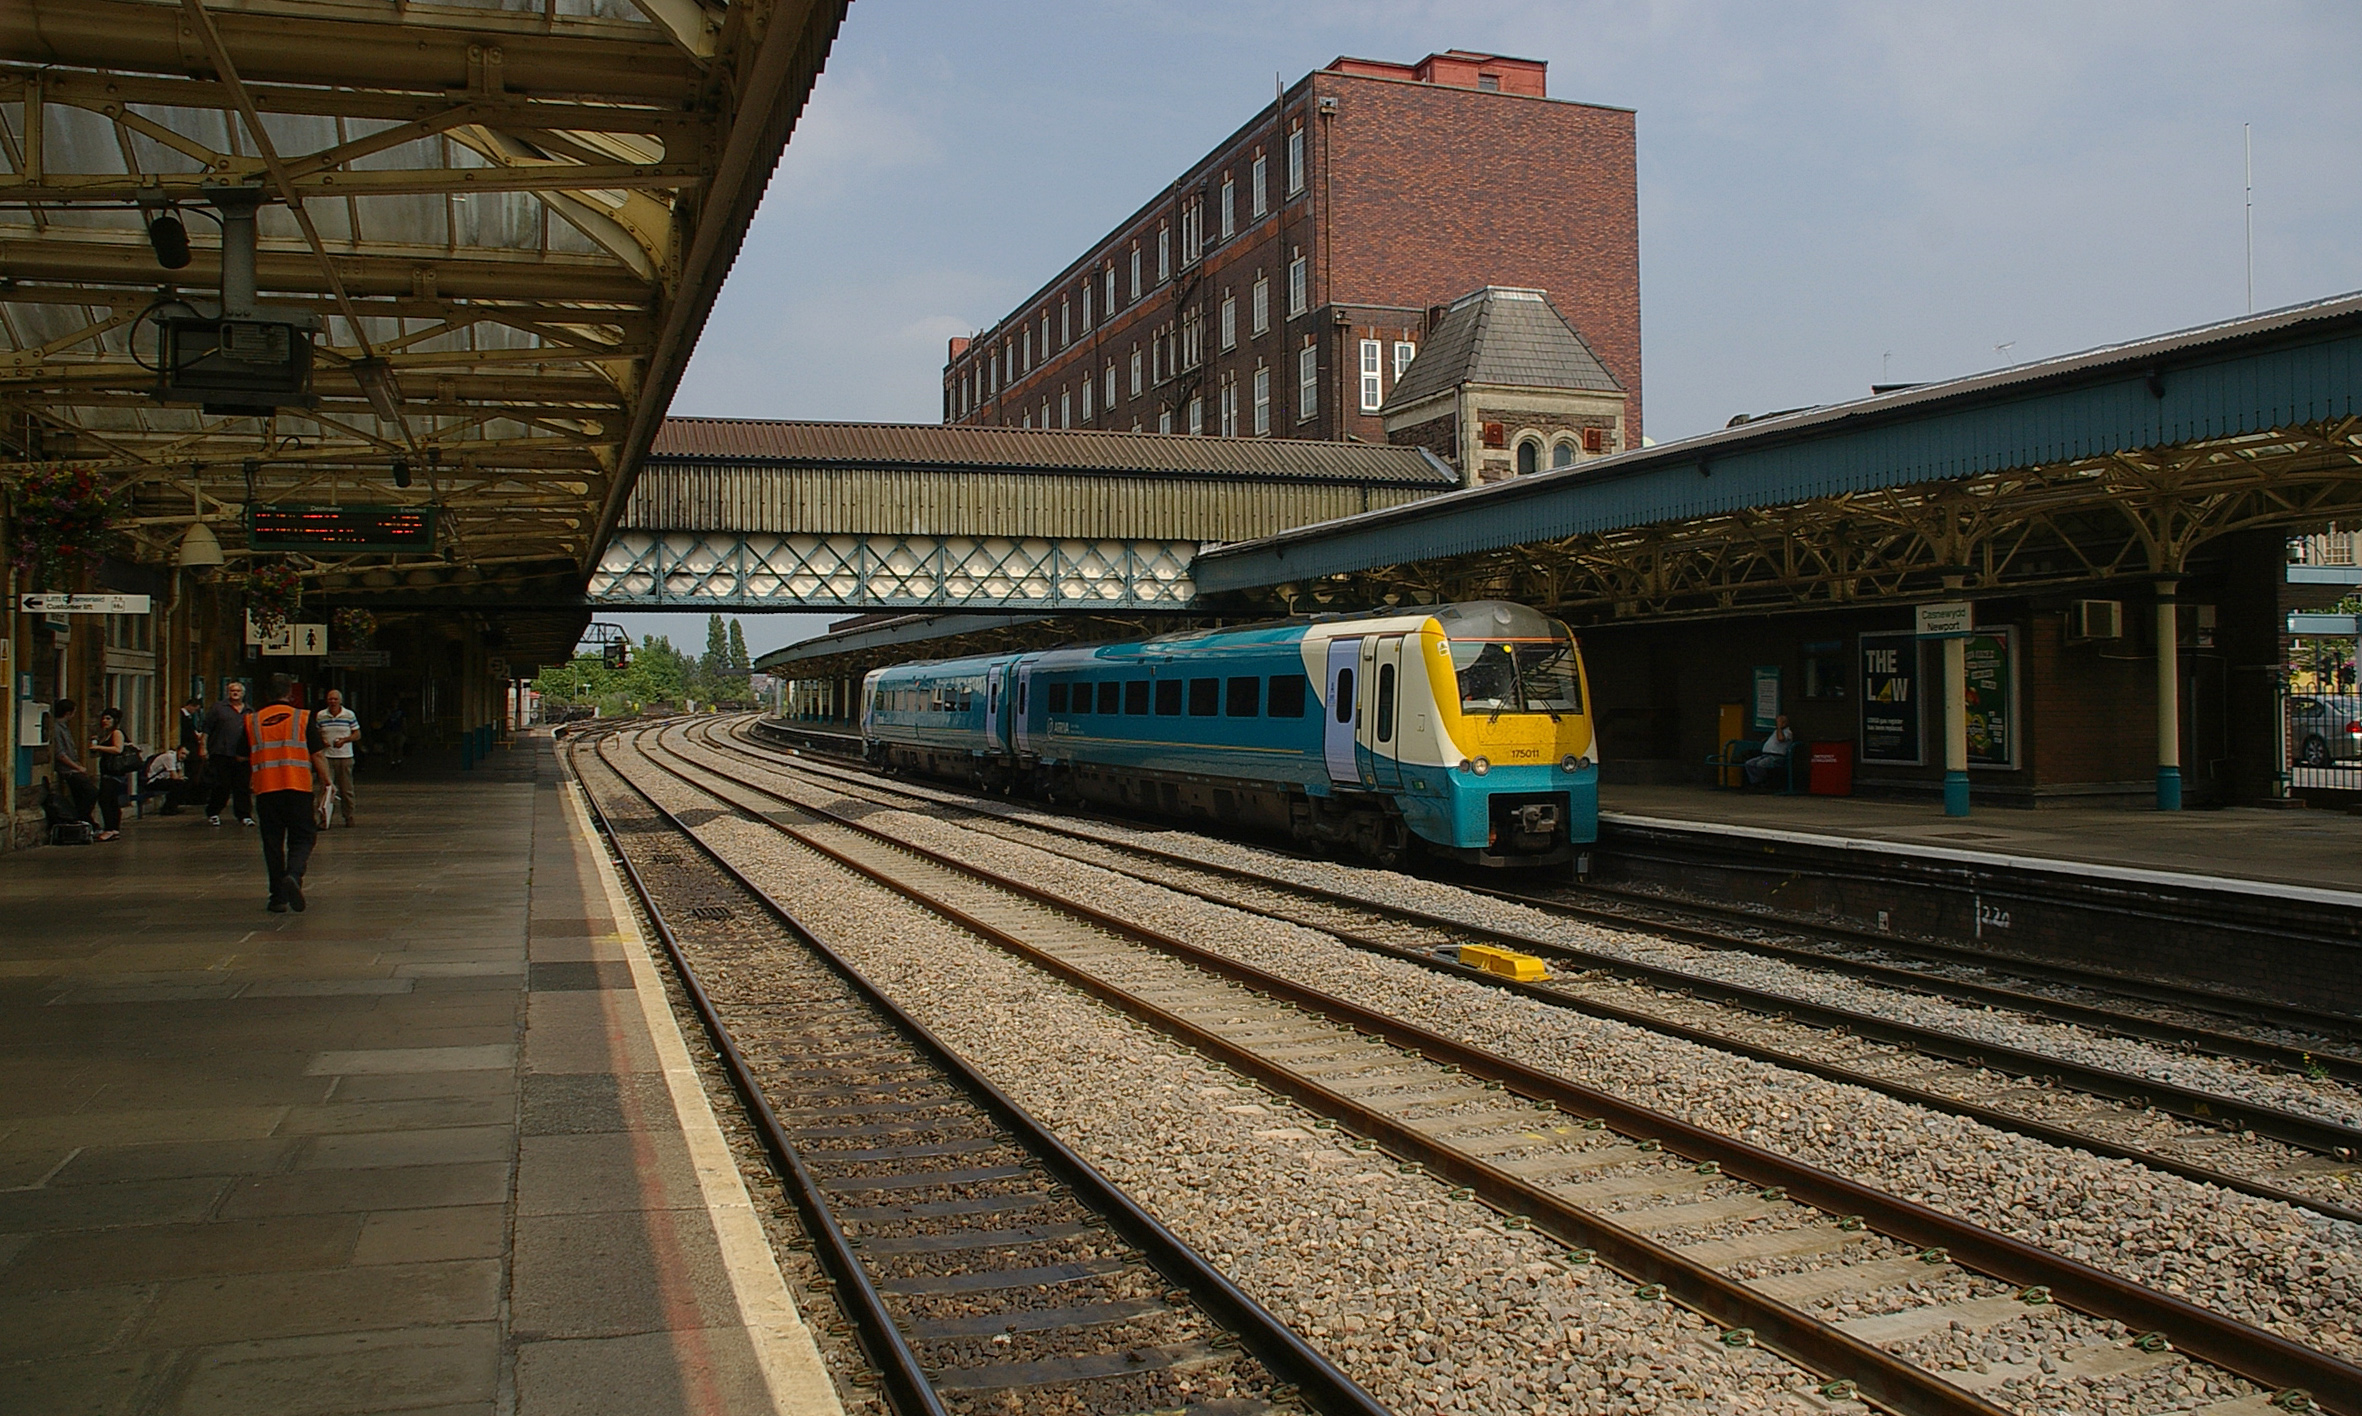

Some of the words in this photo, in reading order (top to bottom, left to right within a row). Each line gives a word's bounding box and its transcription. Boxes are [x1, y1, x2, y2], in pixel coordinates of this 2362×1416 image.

[1922, 608, 1966, 620] Casnewydd
[1927, 621, 1960, 632] Newport
[1865, 649, 1898, 674] THE
[1867, 677, 1909, 703] LAW
[1512, 749, 1539, 758] 175011
